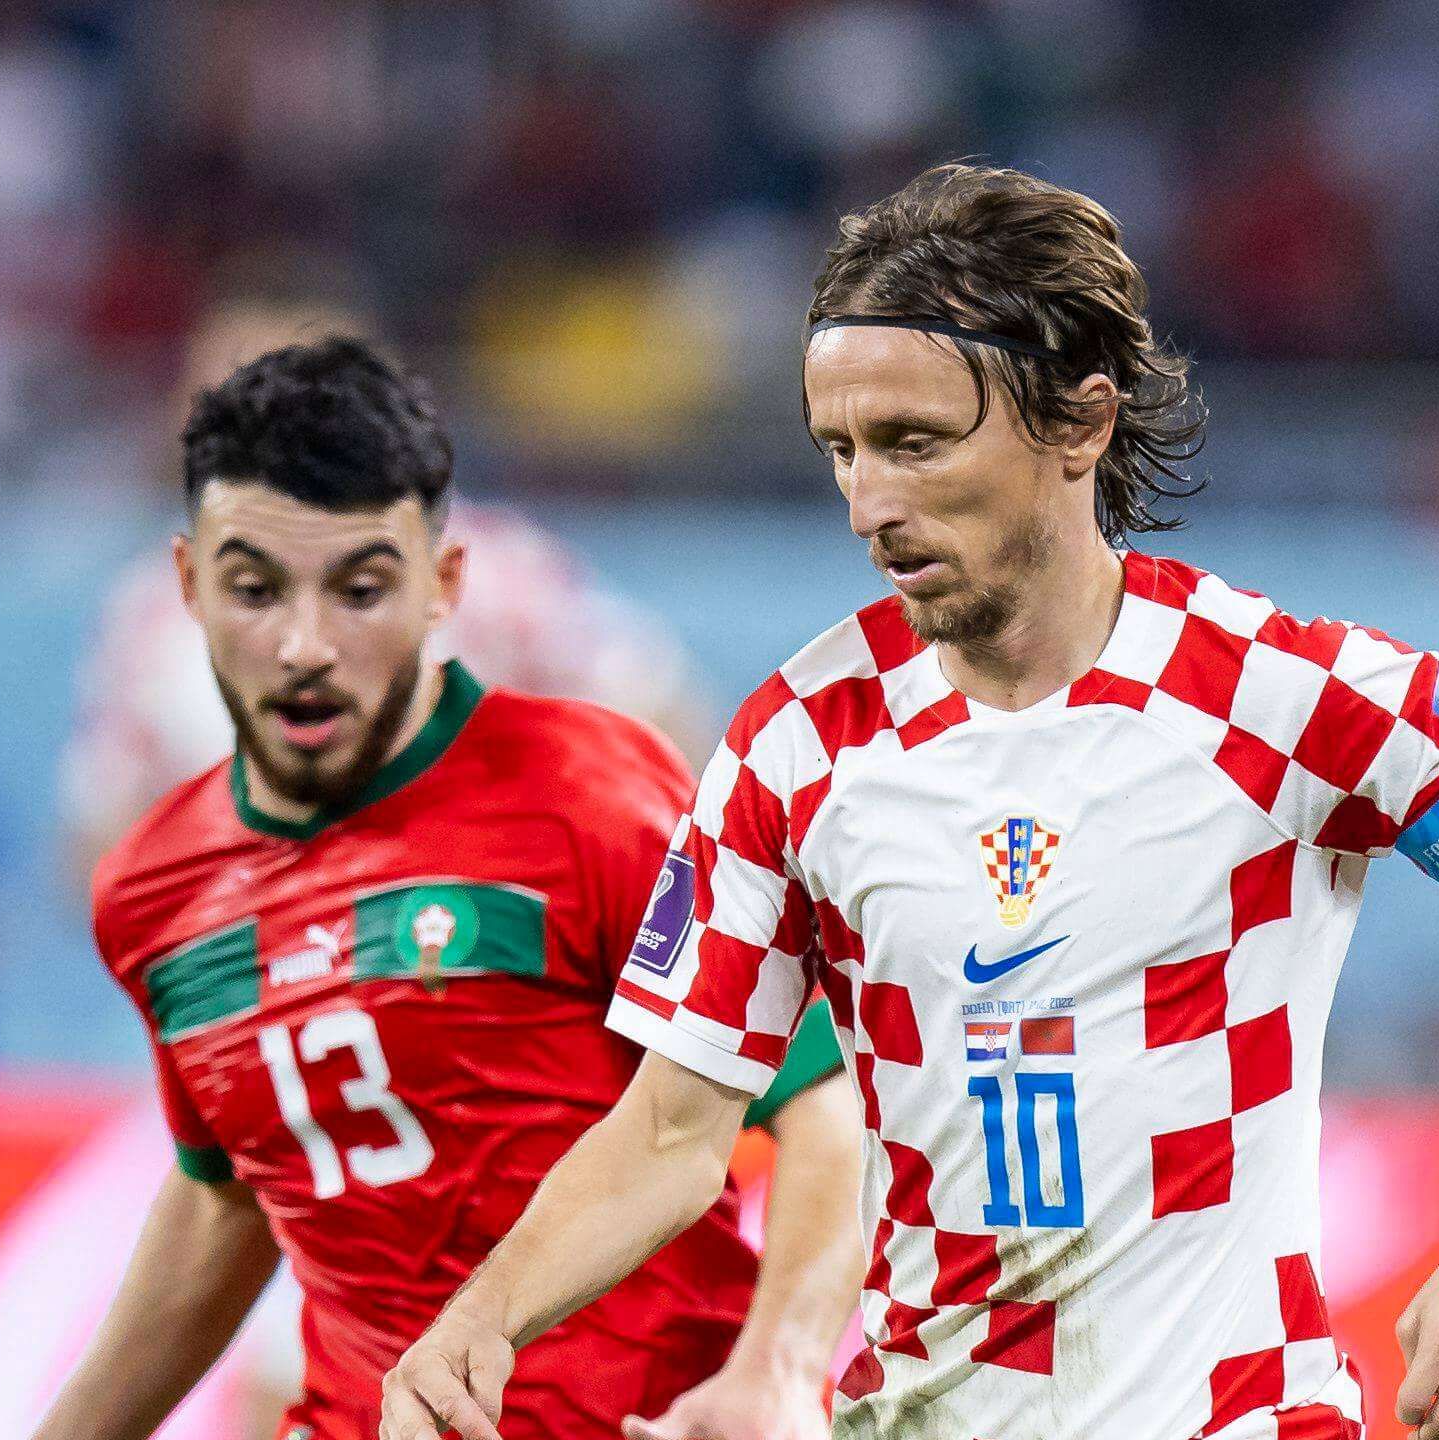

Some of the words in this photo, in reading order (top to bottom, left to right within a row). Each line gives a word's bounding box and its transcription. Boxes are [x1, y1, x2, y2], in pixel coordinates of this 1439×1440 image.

[650, 931, 668, 943] CUP
[961, 1001, 995, 1016] DOHA
[258, 1008, 435, 1199] 13
[968, 1072, 1084, 1227] 10
